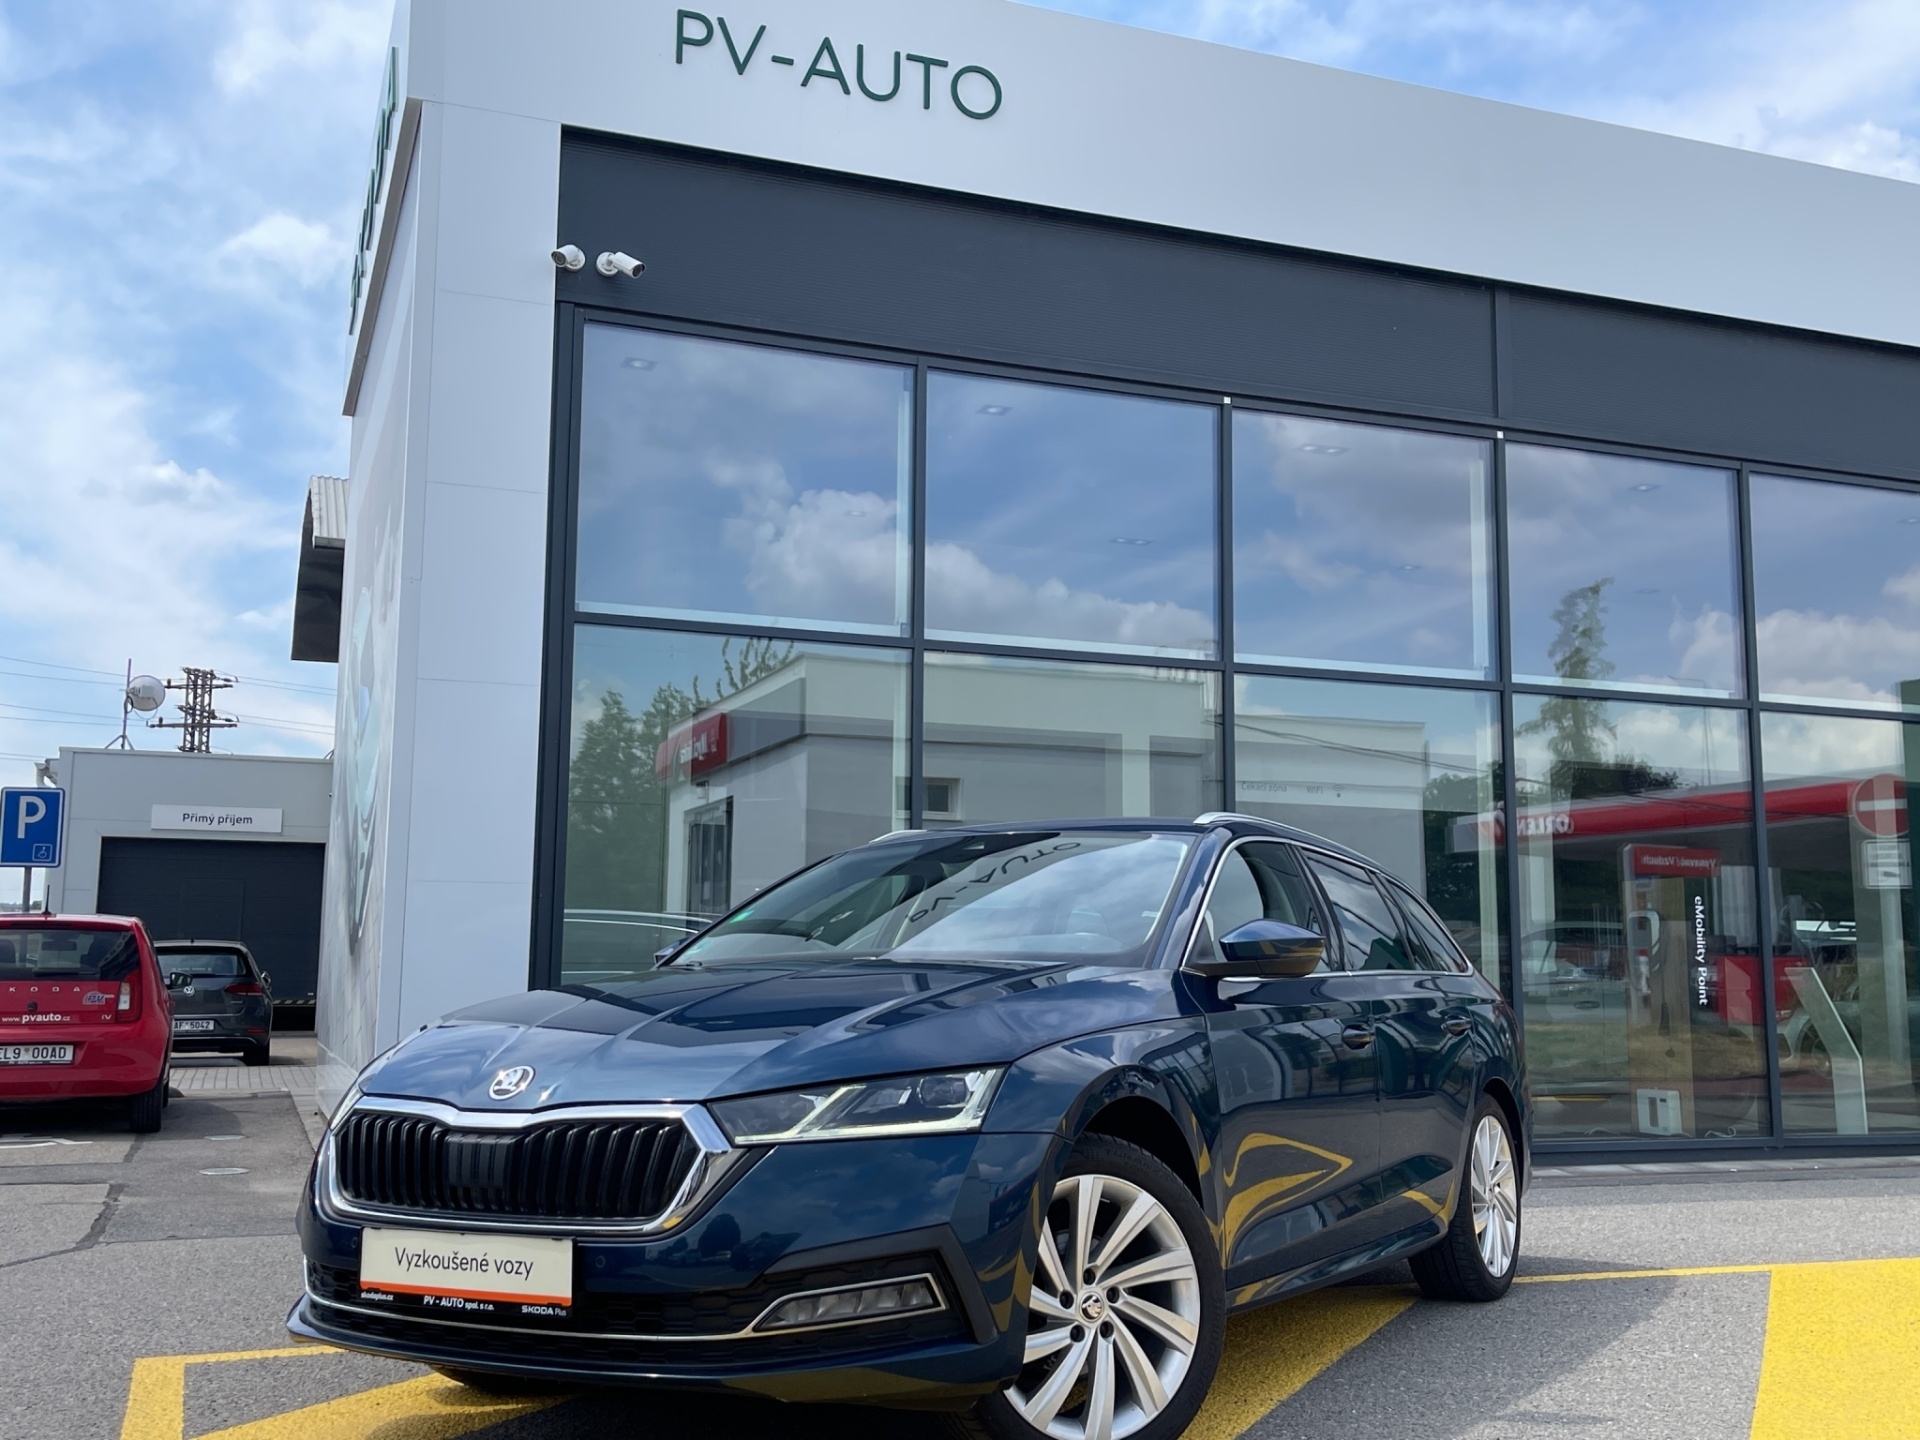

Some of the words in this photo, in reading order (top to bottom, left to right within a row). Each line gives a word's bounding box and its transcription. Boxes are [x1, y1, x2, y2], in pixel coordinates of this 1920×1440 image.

[675, 9, 1002, 120] PV-AUTO
[17, 795, 47, 839] P
[182, 813, 215, 826] Přímý
[217, 814, 253, 827] příjem
[1694, 895, 1706, 963] eMobility
[1698, 967, 1708, 1005] Point
[190, 1021, 210, 1030] 5042
[395, 1246, 489, 1273] Vyzkoušené
[494, 1258, 534, 1281] vozy
[423, 1295, 435, 1305] PV
[440, 1297, 464, 1308] AUTO
[554, 1308, 567, 1316] Plus
